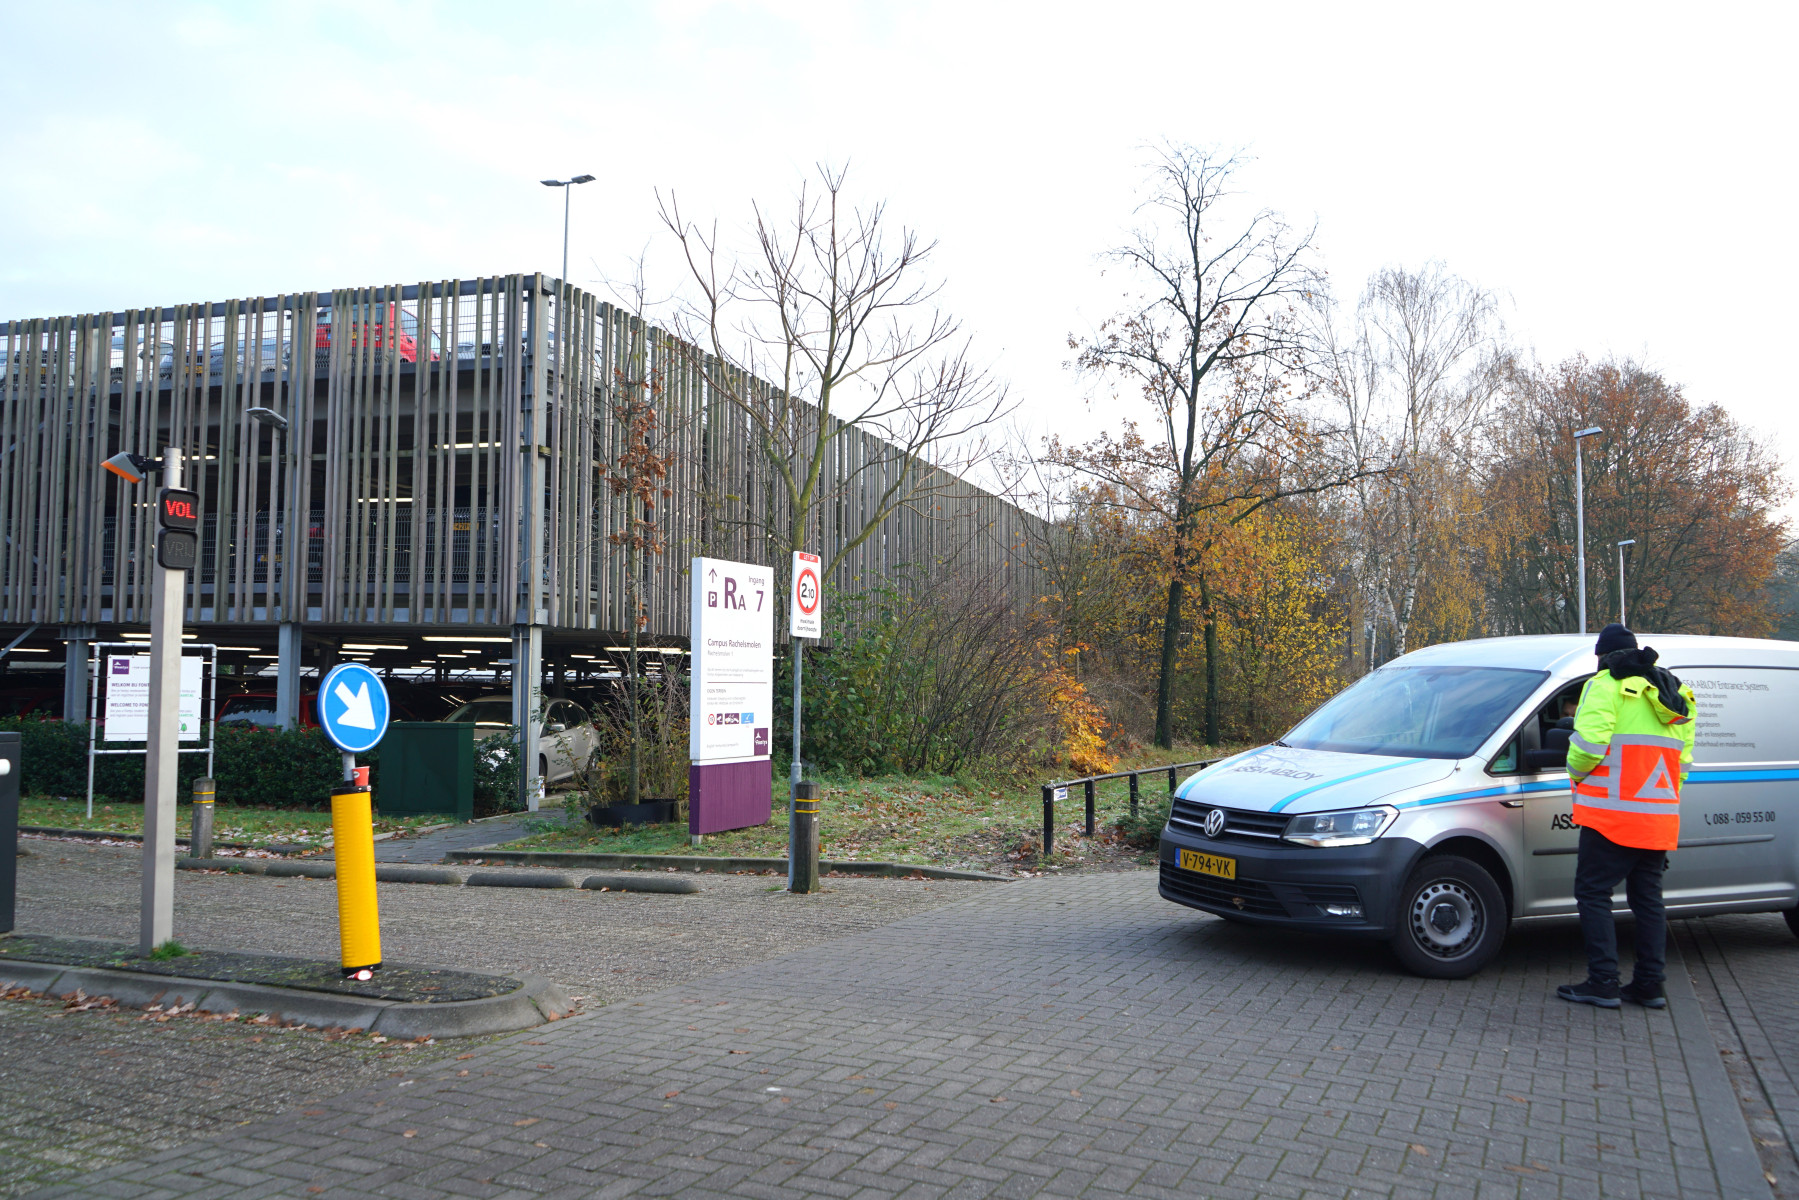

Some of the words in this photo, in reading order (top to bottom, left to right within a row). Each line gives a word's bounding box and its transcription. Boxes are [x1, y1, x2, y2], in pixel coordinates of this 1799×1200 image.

[165, 499, 197, 519] VOL
[165, 541, 195, 558] VRIJ
[748, 576, 765, 587] Ingang
[756, 589, 764, 612] 7
[707, 638, 728, 648] Campus
[728, 639, 762, 649] Rachelsmolen
[1696, 680, 1717, 690] ABLOY
[1717, 681, 1744, 691] Entrance
[1744, 681, 1770, 693] Systems
[1264, 768, 1325, 781] ABLOY
[1713, 812, 1730, 825] 088
[1735, 811, 1752, 824] 059
[1752, 811, 1764, 823] 55
[1764, 810, 1776, 823] 00
[1182, 851, 1231, 877] V-794-VK
